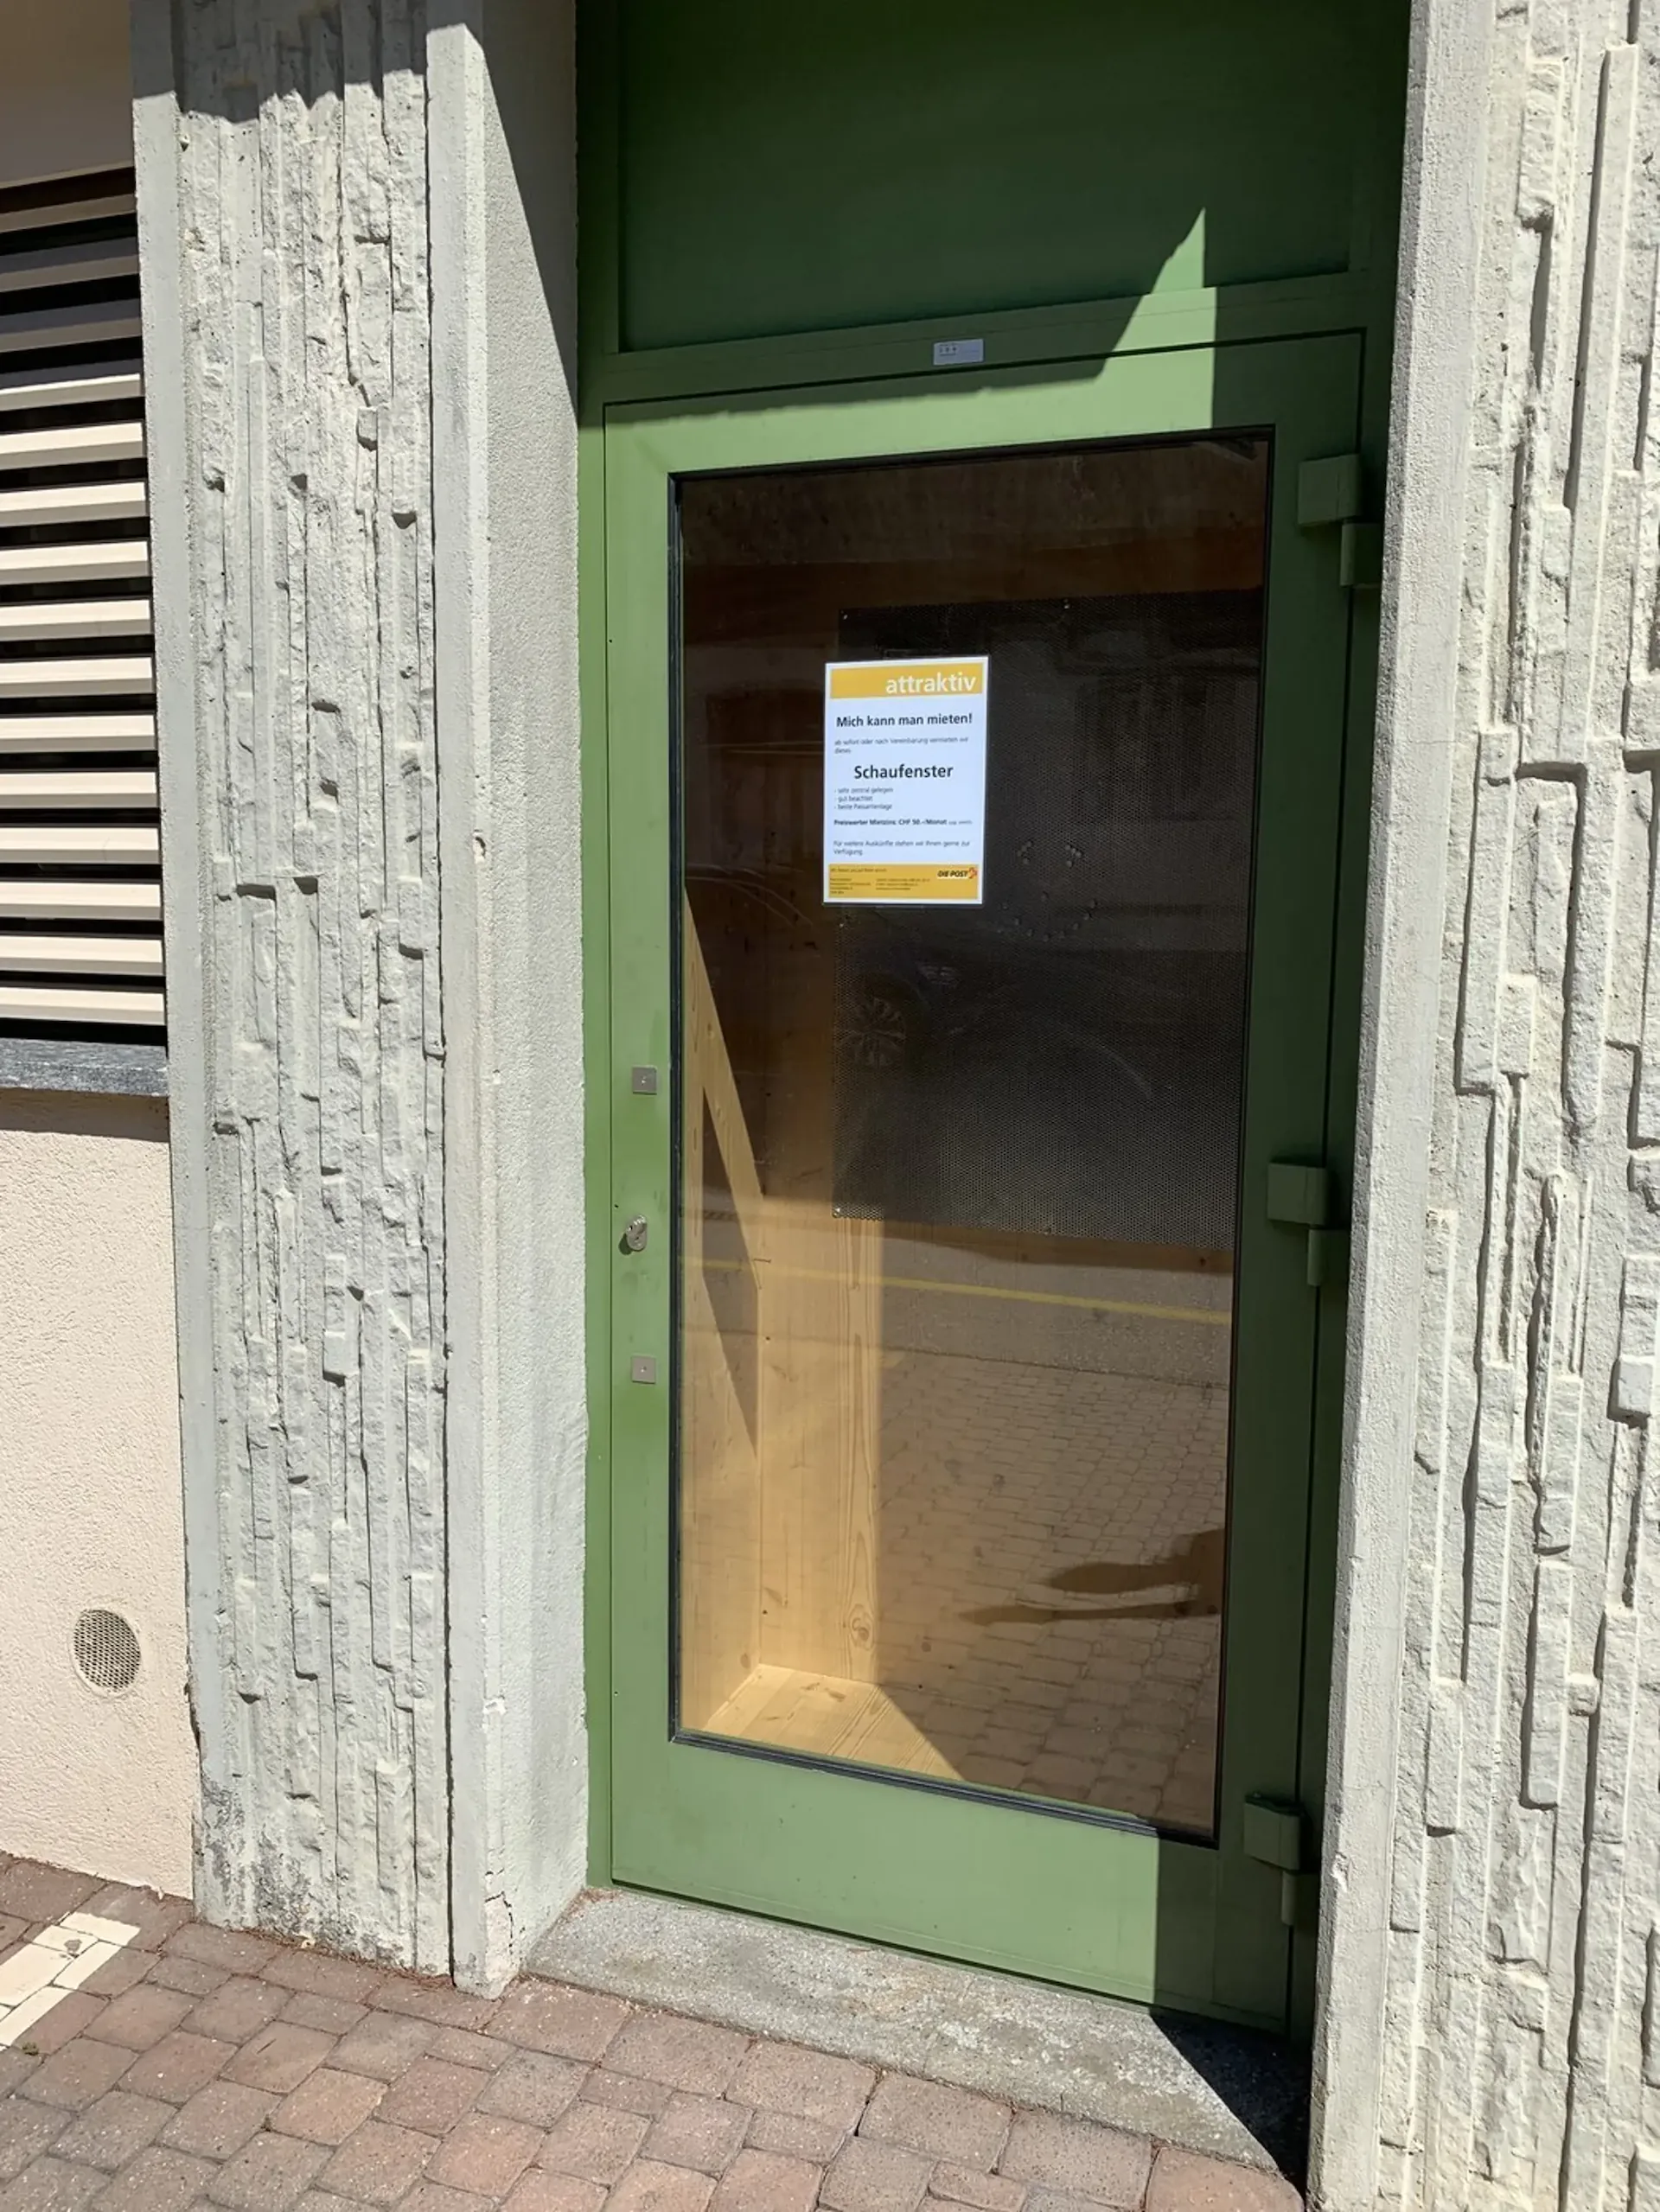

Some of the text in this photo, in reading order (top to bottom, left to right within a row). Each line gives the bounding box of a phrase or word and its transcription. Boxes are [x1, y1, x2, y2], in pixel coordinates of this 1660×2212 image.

[885, 672, 976, 694] attraktiv
[836, 713, 973, 727] Mich kann man mieten!
[854, 763, 954, 779] Schaufenster
